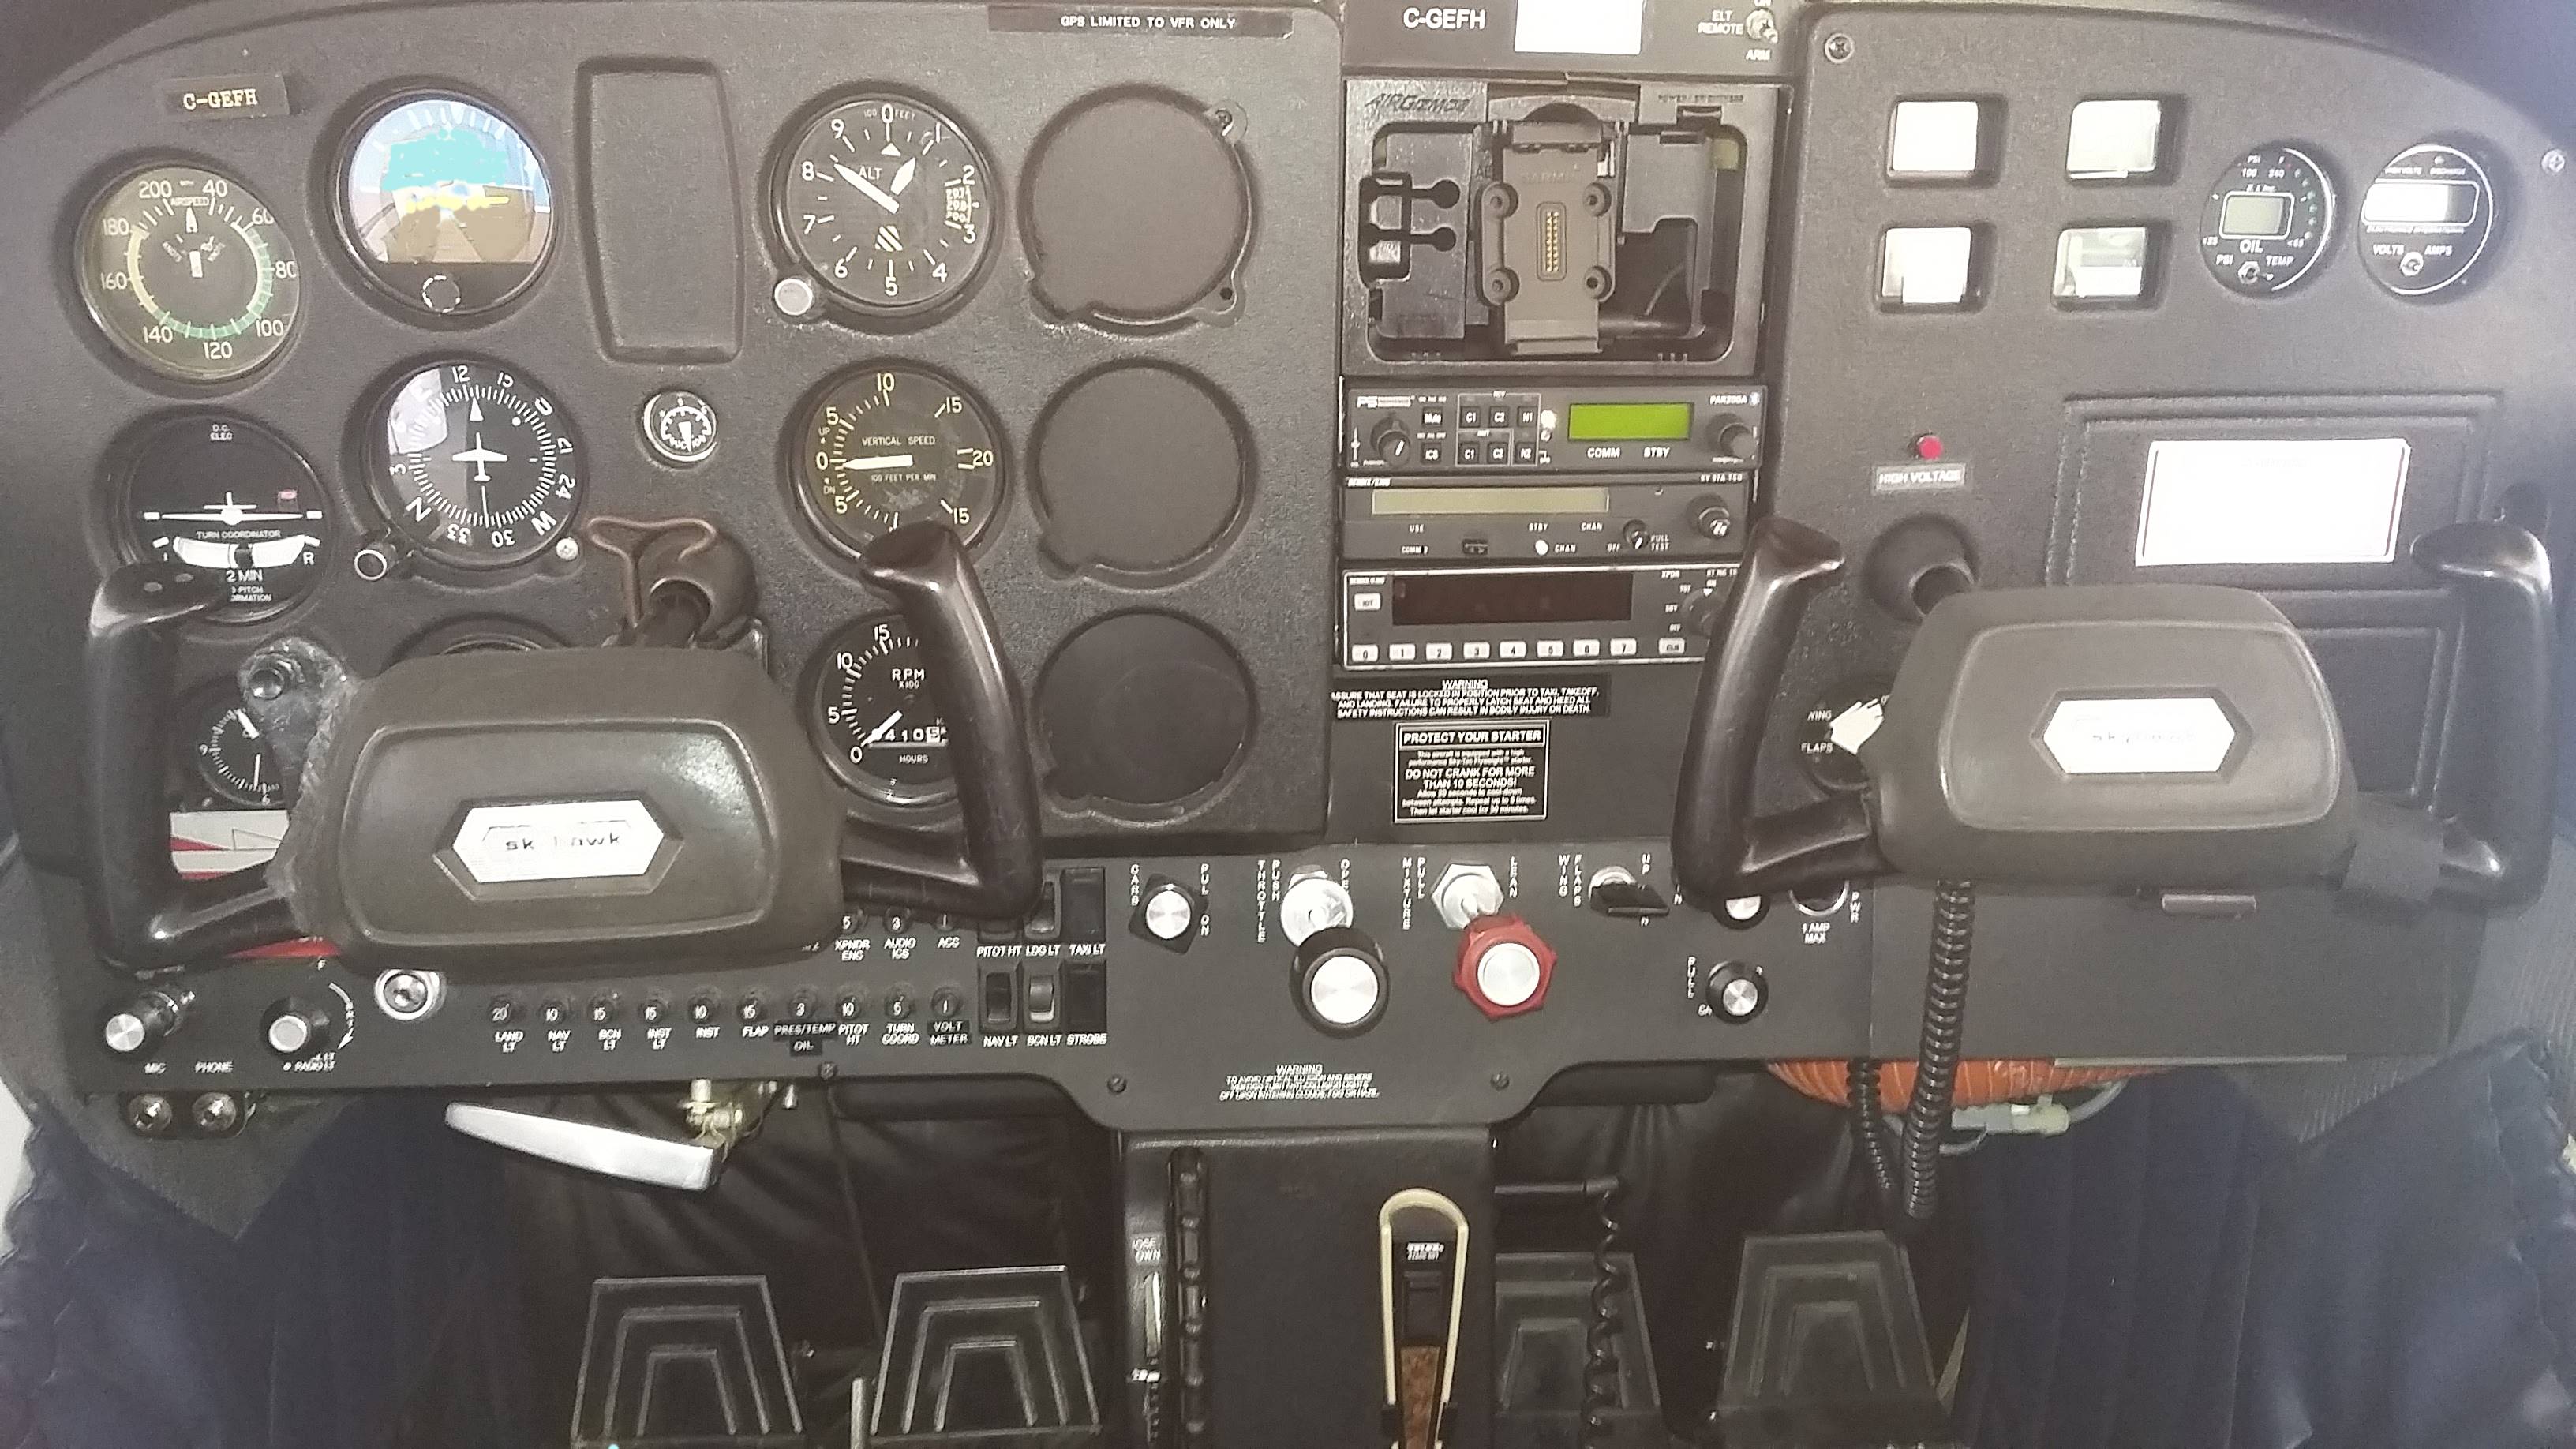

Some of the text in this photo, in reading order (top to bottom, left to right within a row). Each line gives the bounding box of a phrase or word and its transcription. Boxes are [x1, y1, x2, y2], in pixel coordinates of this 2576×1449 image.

[1402, 8, 1486, 31] C-GEFH
[1712, 9, 1733, 22] ELT
[1061, 16, 1236, 30] GPS LIMITED TO VFR ONLY
[1698, 22, 1744, 36] REMOTE
[1745, 48, 1772, 61] ARM
[183, 88, 259, 111] C-GEFH
[882, 103, 894, 123] 0
[831, 119, 845, 138] 9
[802, 160, 814, 180] 8
[859, 166, 883, 182] ALT
[961, 165, 975, 185] 2
[139, 179, 173, 198] 200
[203, 179, 227, 197] 40
[252, 208, 275, 226] 60
[803, 214, 816, 234] 7
[103, 218, 129, 237] 180
[964, 223, 977, 244] 3
[2240, 239, 2263, 253] OIL
[2424, 245, 2452, 256] AMPS
[2266, 255, 2294, 267] TEMP
[276, 261, 298, 279] 80
[835, 259, 848, 278] 6
[932, 262, 948, 282] 4
[102, 272, 128, 290] 160
[885, 276, 898, 296] 5
[144, 324, 173, 344] 140
[256, 320, 283, 337] 100
[204, 341, 233, 360] 120
[453, 365, 470, 384] 12
[877, 372, 895, 391] 10
[946, 396, 963, 414] 15
[826, 406, 839, 426] 5
[861, 435, 936, 446] VERTICAL SPEED
[972, 449, 994, 467] 20
[1587, 447, 1622, 458] COMM
[1643, 447, 1672, 458] STBY
[816, 452, 828, 471] 0
[905, 474, 921, 482] PER
[1879, 470, 1962, 485] HIGH VOLTAGE
[556, 474, 576, 500] 24
[407, 496, 432, 522] N
[834, 496, 848, 515] 5
[532, 510, 557, 535] W
[953, 507, 970, 526] 15
[447, 523, 472, 544] 33
[1529, 522, 1549, 532] STBY
[1581, 522, 1603, 531] CHAN
[196, 529, 282, 540] TURN COORDINATOR
[492, 529, 515, 548] 30
[1555, 544, 1577, 553] CHAN
[303, 551, 315, 565] R
[227, 569, 263, 582] 2 MIN
[874, 623, 890, 642] 15
[837, 653, 853, 670] 10
[892, 668, 926, 681] RPM
[1442, 680, 1488, 690] WARNING
[828, 706, 841, 724] 5
[1403, 729, 1541, 745] PROTECT YOUR STARTER
[850, 746, 863, 764] 0
[1801, 742, 1833, 754] FLAPS
[899, 754, 928, 764] HOURS
[1405, 766, 1536, 781] DO NOT CRANK FOR MORE
[1424, 778, 1451, 790] THAN
[1453, 778, 1464, 789] 10
[1642, 854, 1651, 874] UP
[1271, 859, 1280, 901] PUSH
[1417, 857, 1426, 900] PULL
[1509, 856, 1518, 898] LEAN
[1558, 855, 1570, 897] WING
[1574, 854, 1582, 907] FLAPS
[1130, 863, 1140, 906] CARB
[1402, 857, 1412, 930] MIXTURE
[1257, 859, 1266, 943] THROTTLE
[1200, 915, 1210, 935] ON
[1808, 923, 1830, 933] AMP
[835, 939, 871, 952] XPNDR
[884, 938, 917, 950] AUDIO
[1804, 933, 1827, 945] MAX
[891, 949, 910, 960] ICS
[977, 945, 1023, 958] PITOT HT
[1047, 943, 1061, 957] LT
[1687, 956, 1697, 999] PULL
[545, 1008, 559, 1021] 10
[593, 1007, 607, 1020] 15
[645, 1006, 658, 1020] 15
[694, 1005, 708, 1019] 10
[743, 1003, 756, 1017] 15
[796, 1002, 806, 1017] 3
[843, 1002, 856, 1016] 10
[696, 1027, 721, 1039] INST
[743, 1025, 769, 1038] FLAP
[773, 1022, 837, 1035] PRES/TEMP
[837, 1023, 869, 1035] PITOT
[886, 1022, 915, 1035] TURN
[933, 1020, 964, 1032] VOLT
[495, 1030, 524, 1043] LAND
[548, 1029, 571, 1041] NAV
[598, 1028, 622, 1040] BCN
[646, 1028, 672, 1039] INST
[845, 1034, 862, 1046] HT
[881, 1033, 920, 1046] COORD
[929, 1033, 969, 1046] METER
[983, 1034, 1019, 1047] NAV LT
[1027, 1033, 1063, 1047] BCN LT
[1066, 1032, 1108, 1046] STROBE
[502, 1041, 516, 1053] LT
[552, 1039, 566, 1052] LT
[602, 1039, 618, 1051] LT
[652, 1038, 667, 1050] LT
[793, 1039, 814, 1052] OIL
[194, 1061, 235, 1073] PHONE
[1276, 1064, 1324, 1074] WARNING
